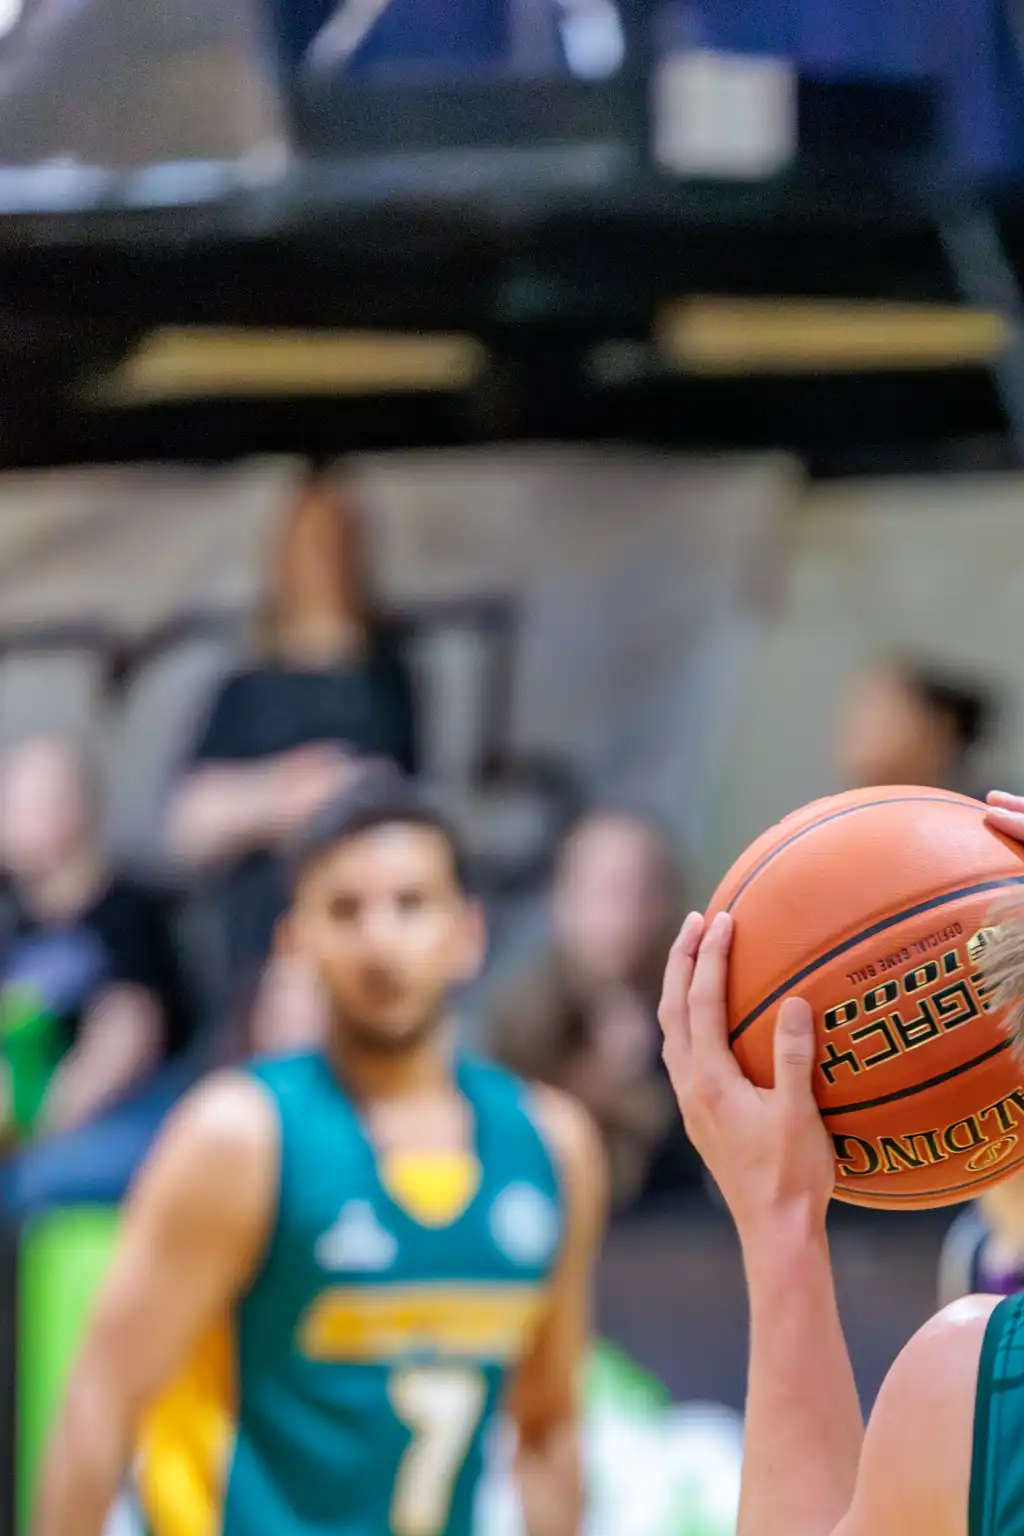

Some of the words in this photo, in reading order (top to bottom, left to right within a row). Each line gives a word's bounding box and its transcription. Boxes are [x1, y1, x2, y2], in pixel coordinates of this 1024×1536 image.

[910, 922, 963, 954] OFFICIAL
[876, 947, 910, 972] GAME
[846, 964, 877, 985] BALL
[823, 948, 965, 1033] 1000
